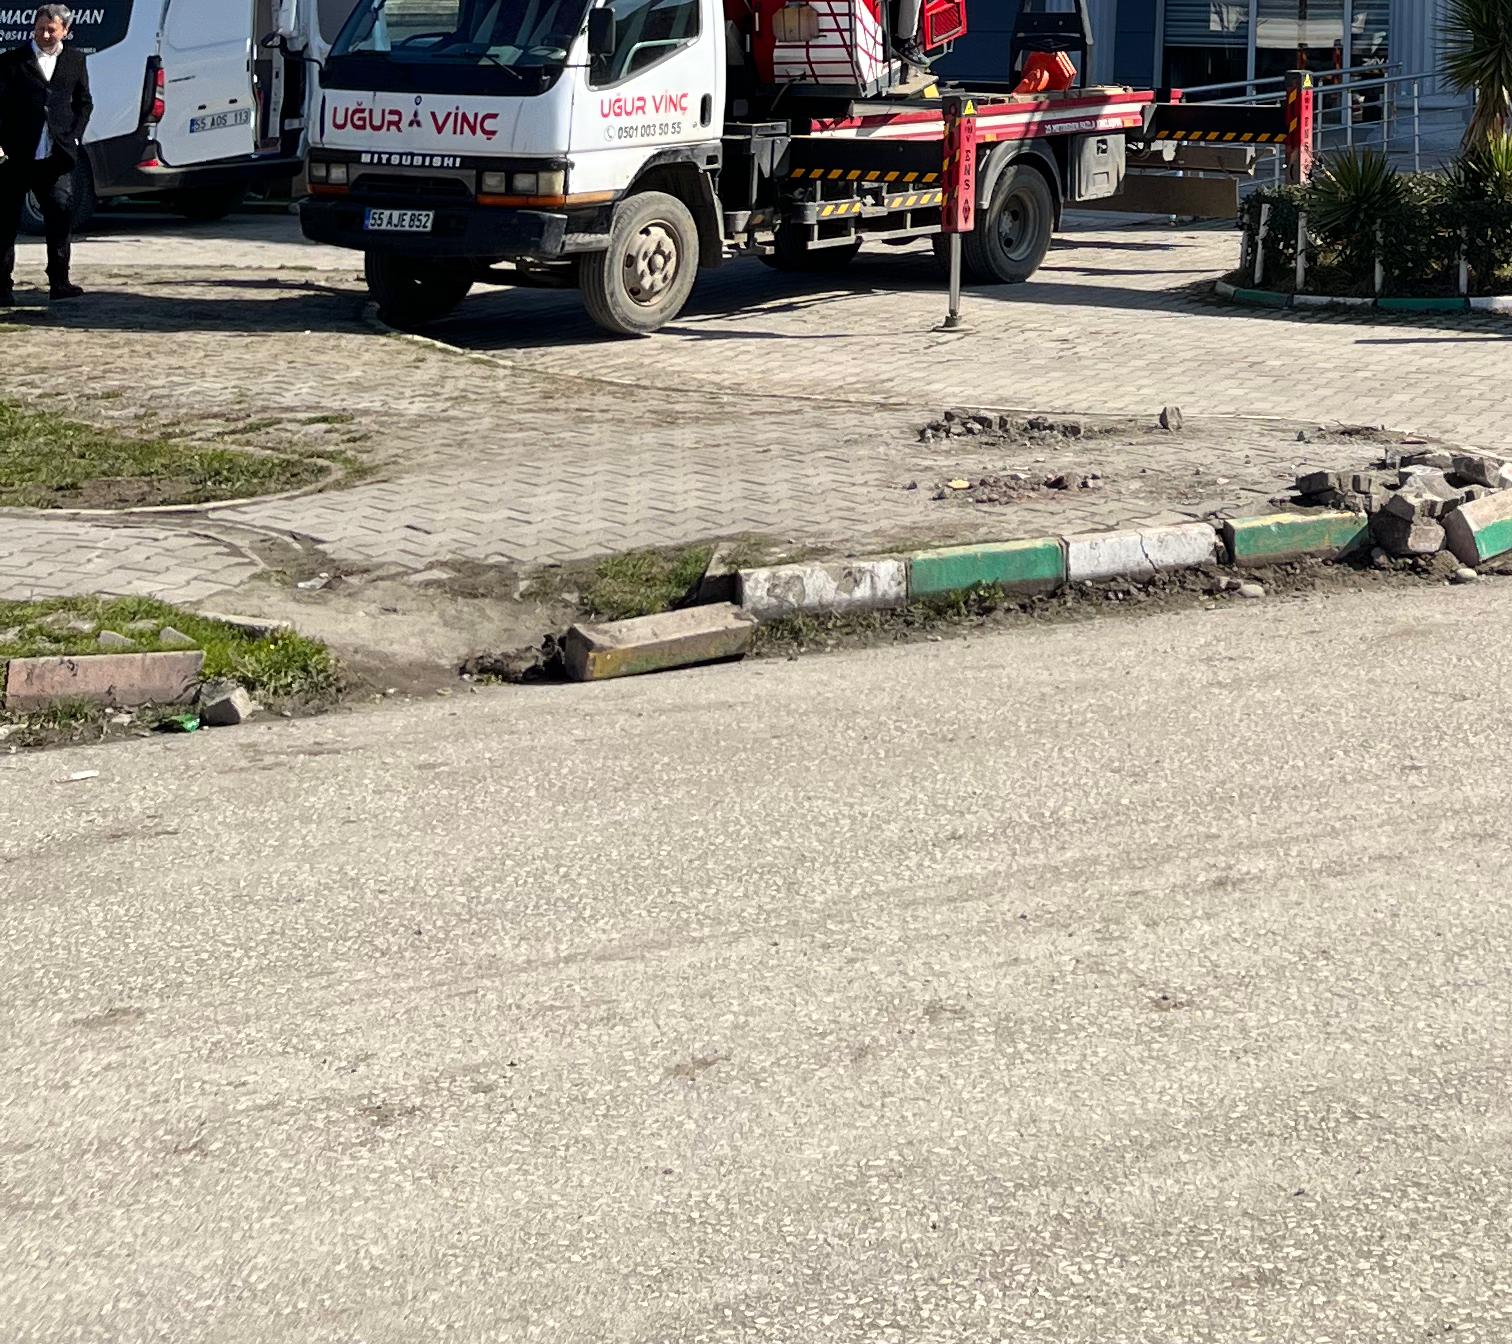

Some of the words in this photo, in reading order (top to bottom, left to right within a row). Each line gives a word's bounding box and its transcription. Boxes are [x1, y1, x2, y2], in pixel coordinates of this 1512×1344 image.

[600, 92, 647, 118] UĞUR
[652, 89, 689, 115] VİNÇ
[332, 100, 403, 133] UĞUR
[430, 105, 500, 140] VİNÇ
[617, 125, 639, 140] 0501
[640, 124, 656, 138] 003
[659, 123, 669, 136] 50
[671, 122, 682, 135] 55
[361, 153, 462, 168] MITSUBISHI
[369, 211, 384, 228] 55
[386, 211, 407, 229] AJE
[408, 212, 431, 230] 852
